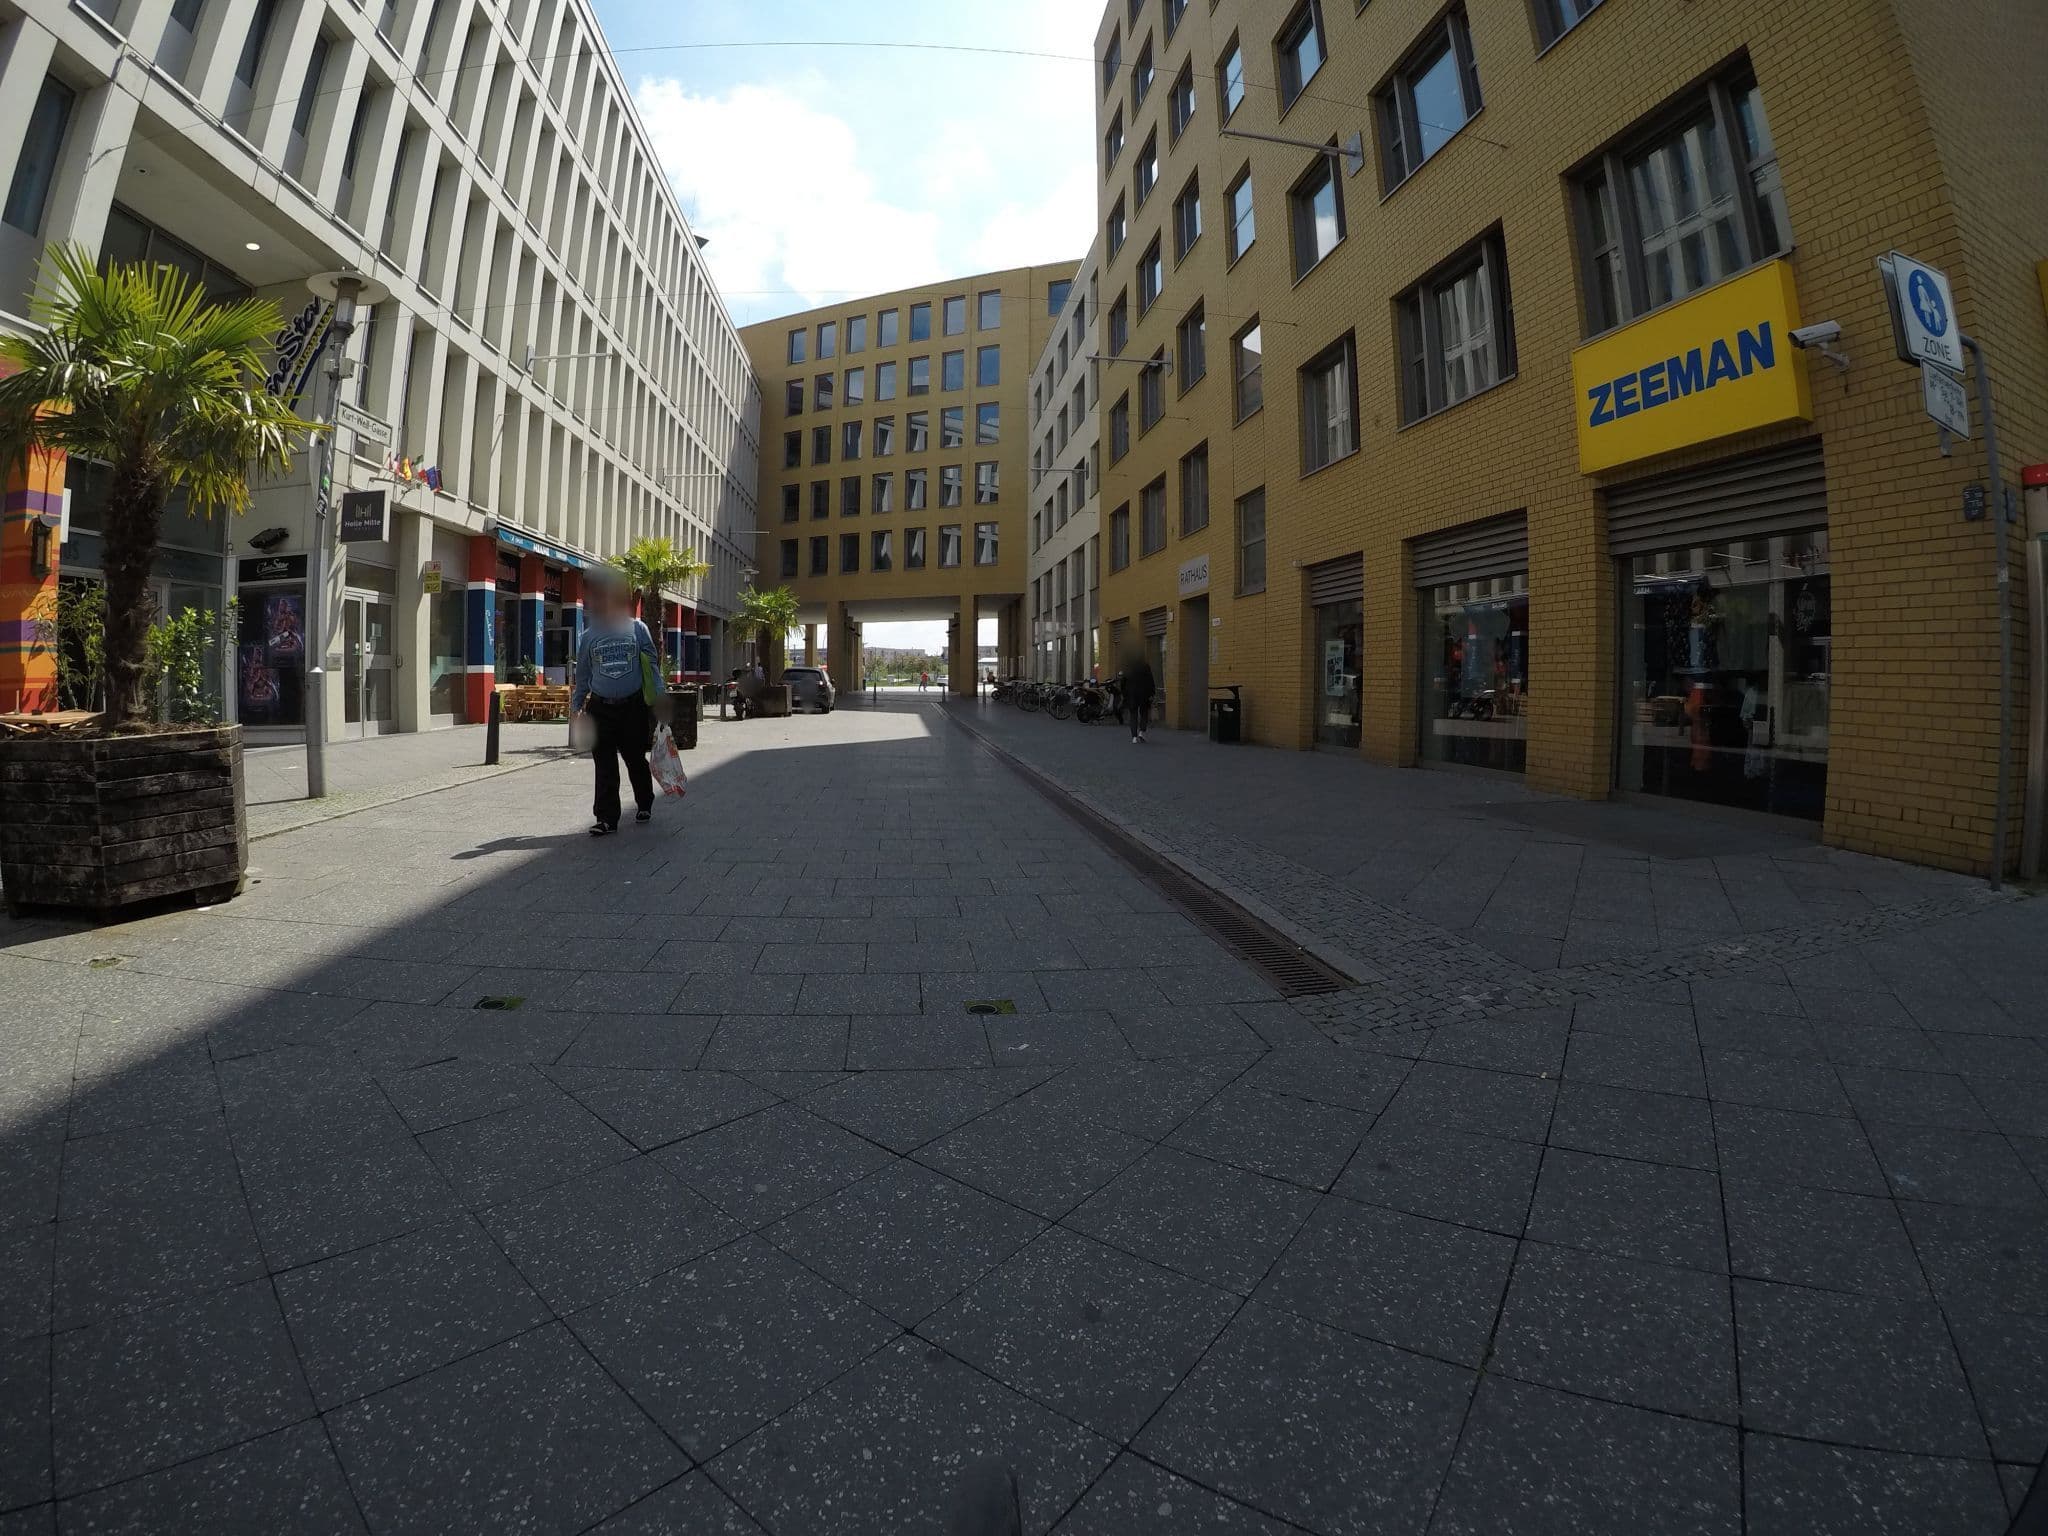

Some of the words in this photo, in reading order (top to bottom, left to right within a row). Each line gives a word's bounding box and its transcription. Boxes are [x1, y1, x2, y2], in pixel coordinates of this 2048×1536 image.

[1922, 336, 1952, 361] ZONE
[1588, 320, 1776, 428] ZEEMAN
[1180, 564, 1208, 584] RATHAUS
